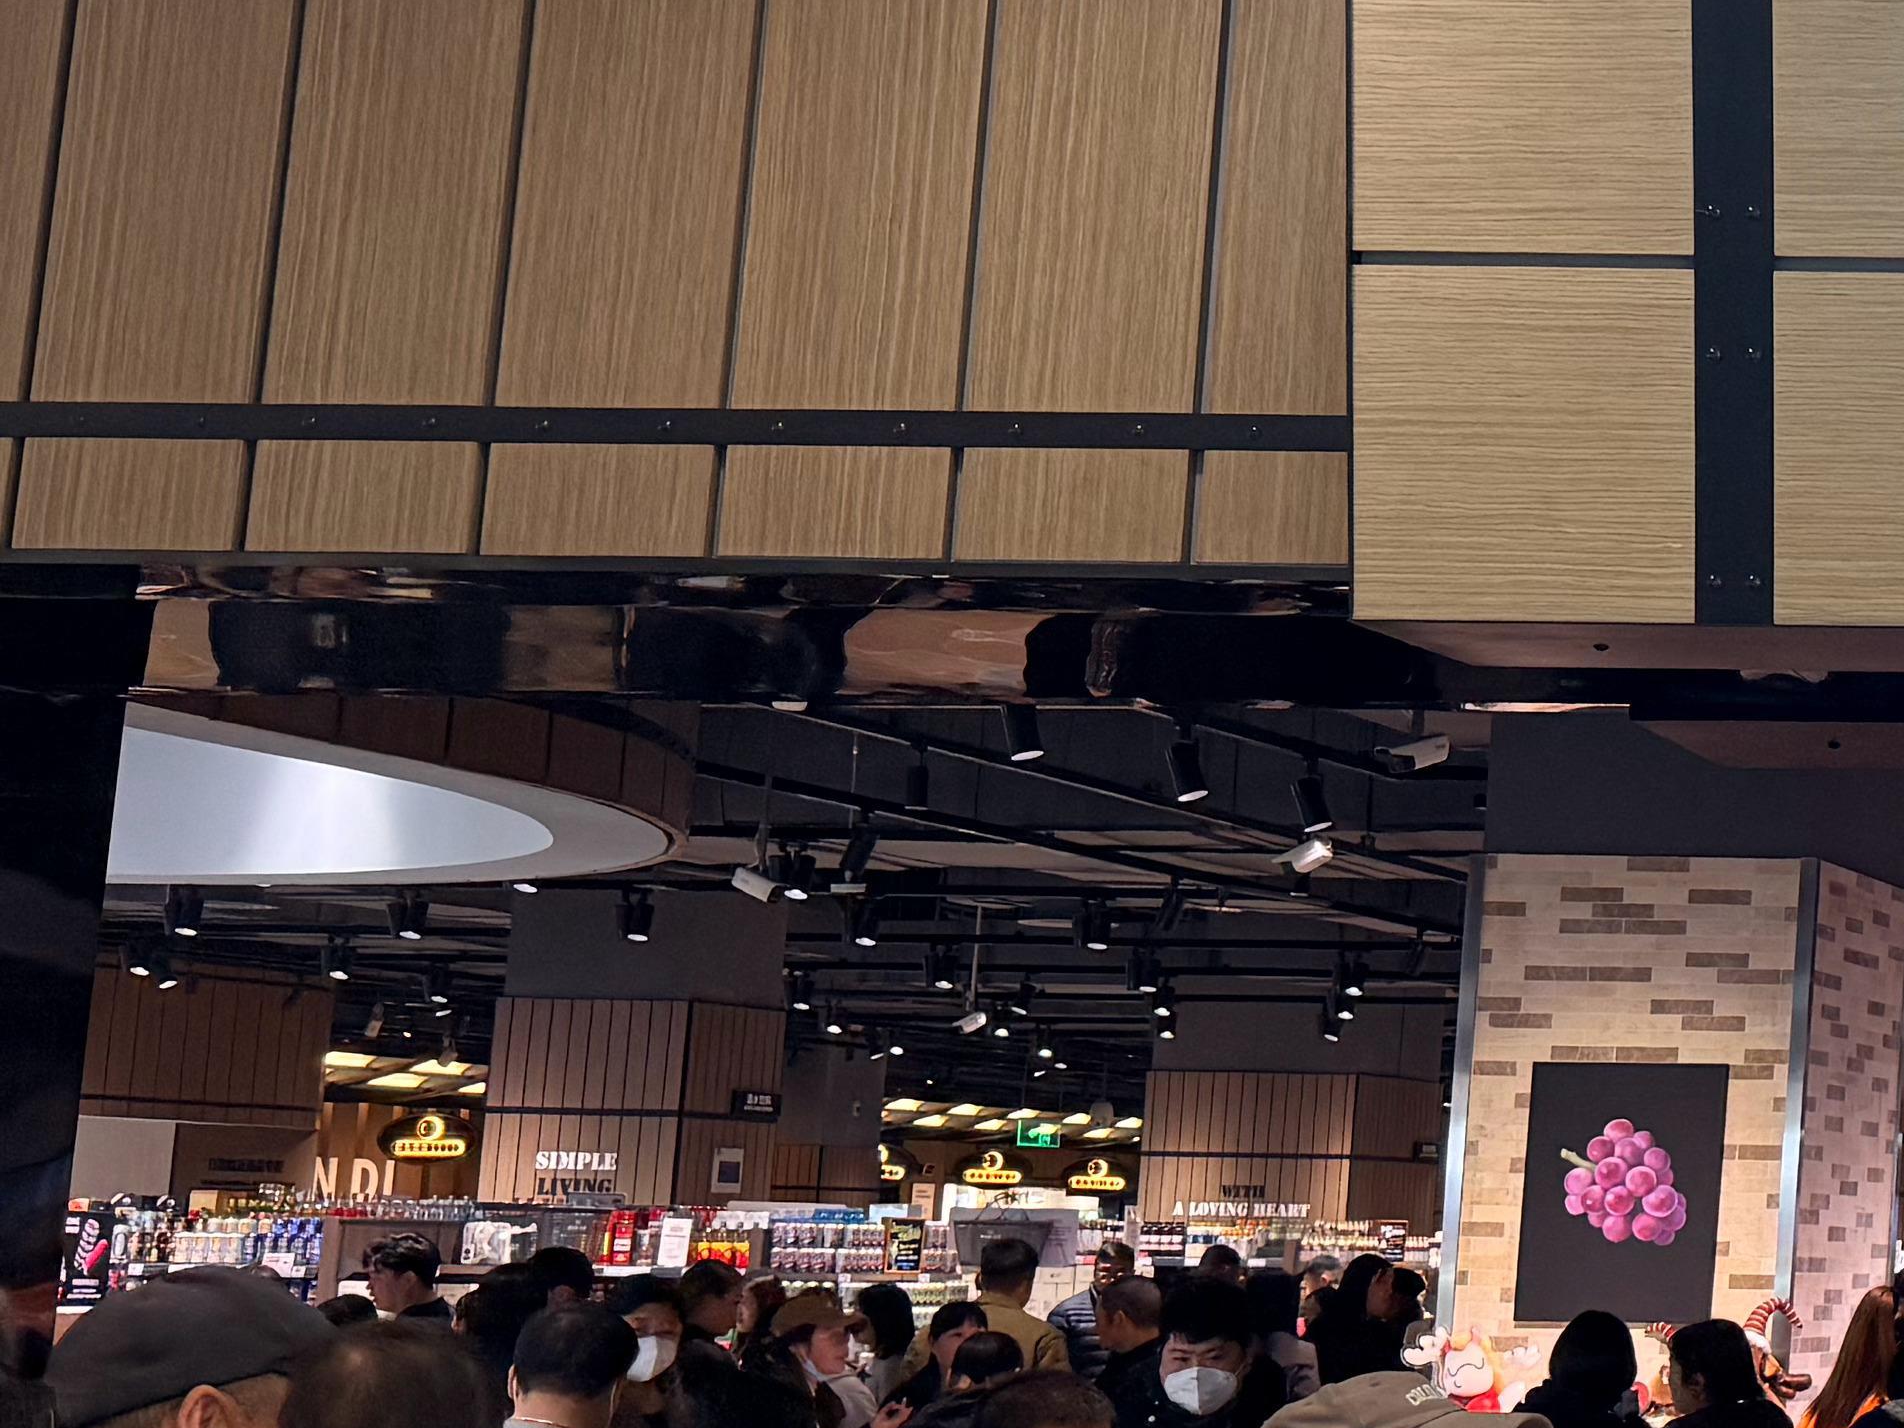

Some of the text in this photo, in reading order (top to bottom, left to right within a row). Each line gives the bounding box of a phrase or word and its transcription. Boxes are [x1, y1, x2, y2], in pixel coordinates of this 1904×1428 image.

[535, 1150, 618, 1171] SIMPLE
[537, 1177, 613, 1196] LIVING
[1172, 1201, 1311, 1218] A LOVING HEART
